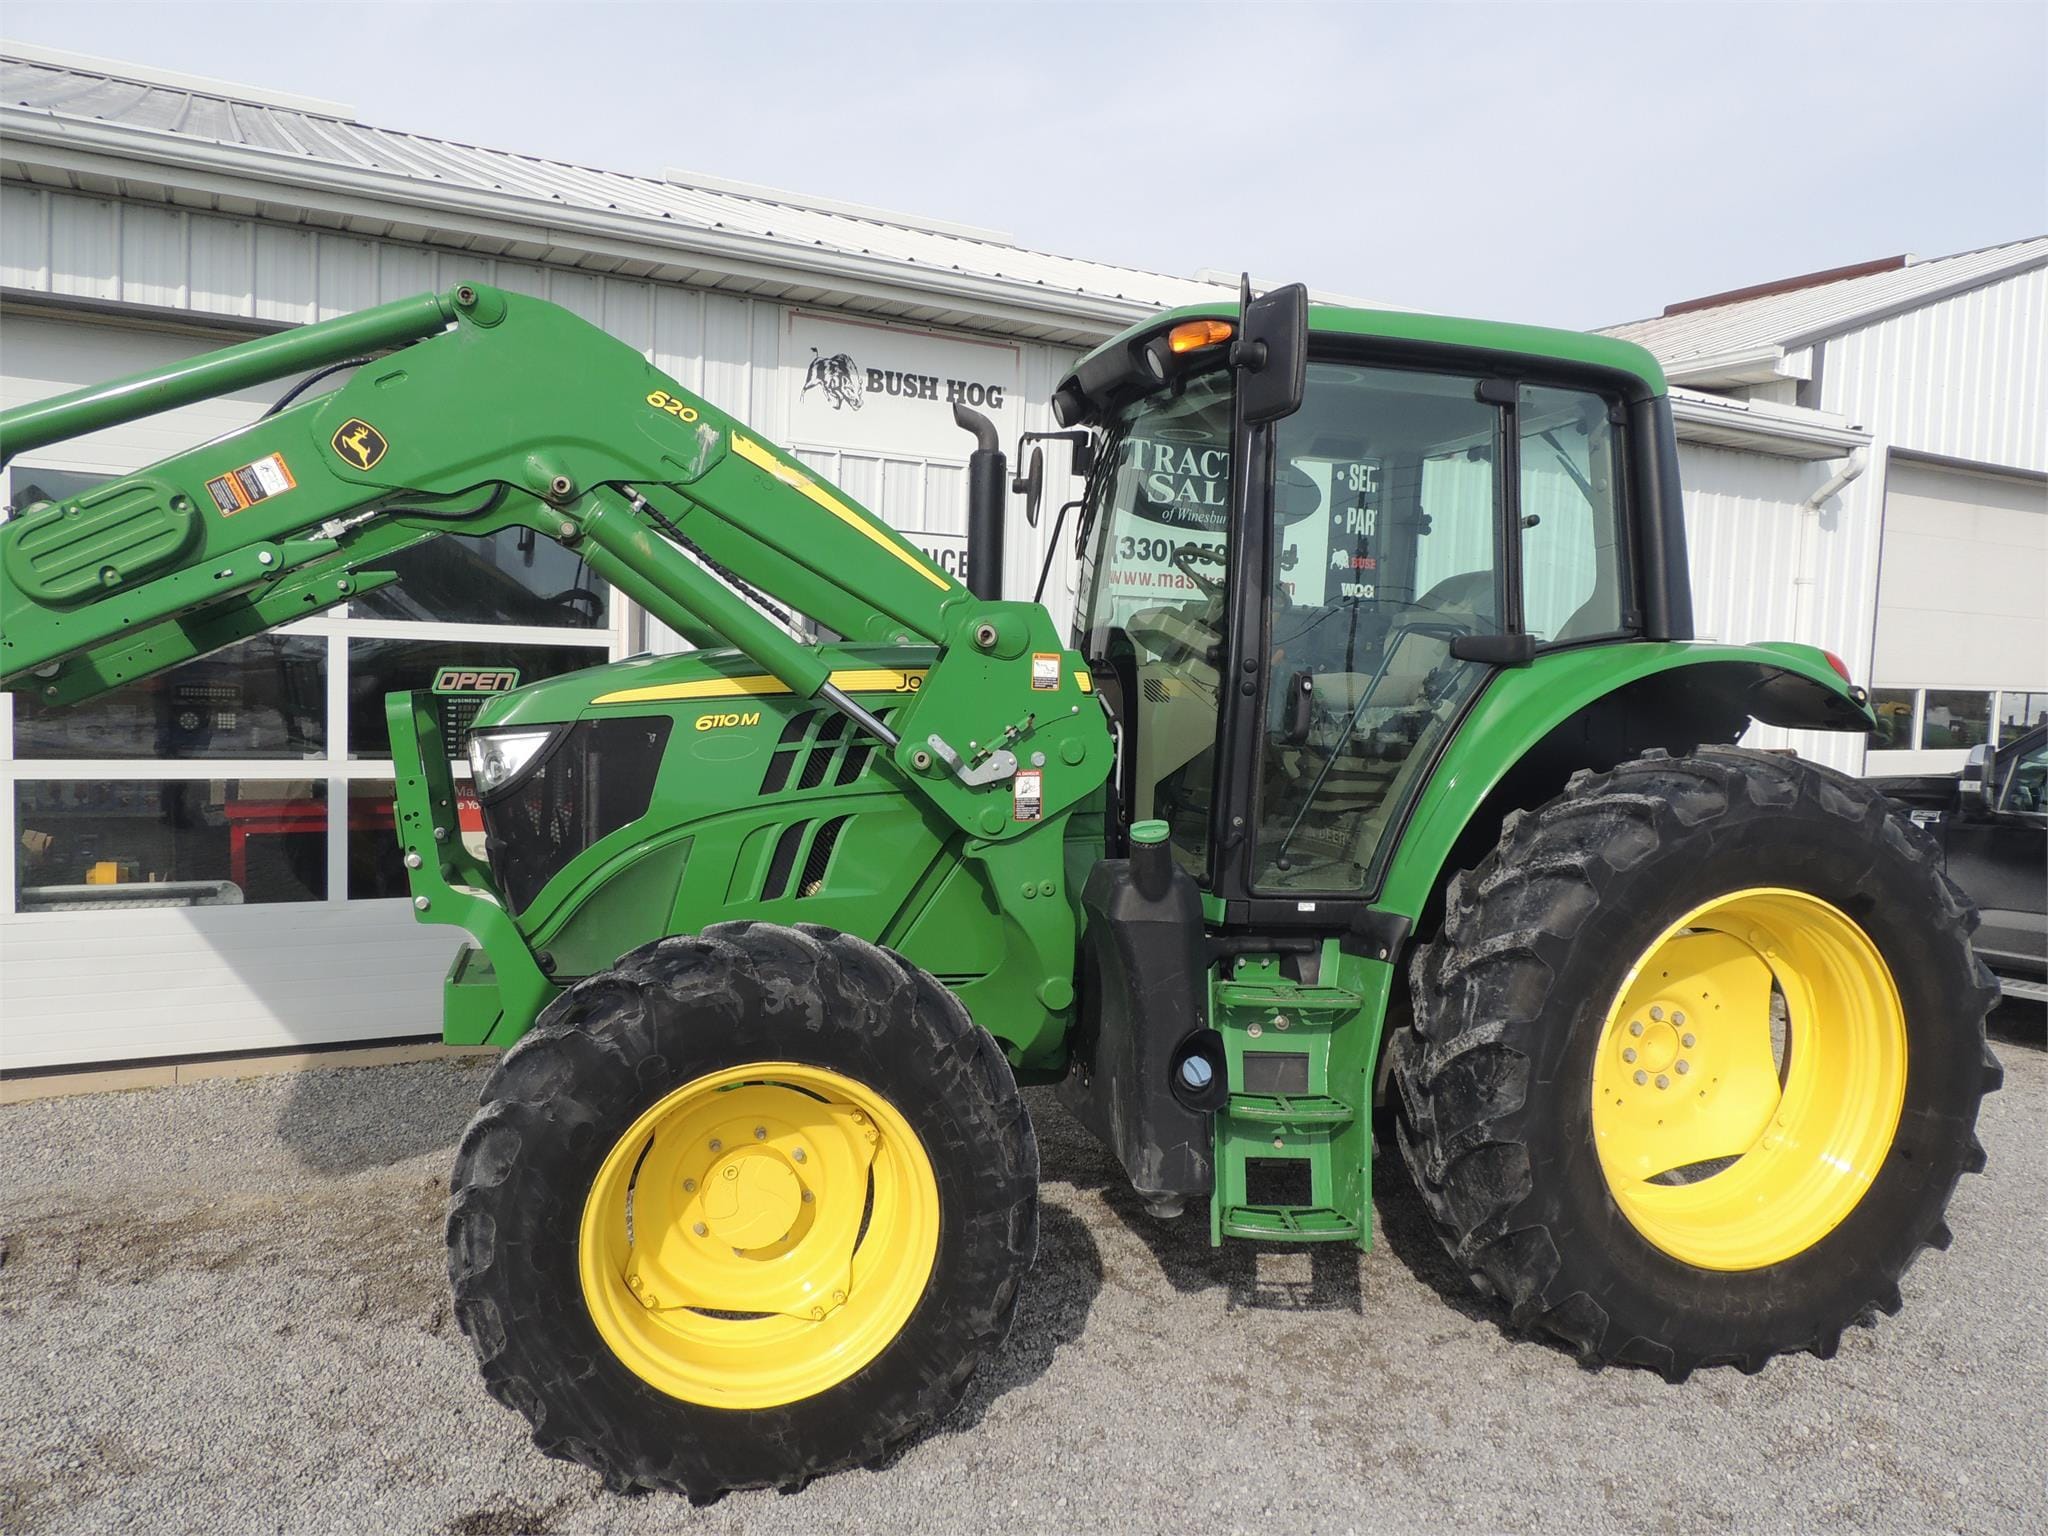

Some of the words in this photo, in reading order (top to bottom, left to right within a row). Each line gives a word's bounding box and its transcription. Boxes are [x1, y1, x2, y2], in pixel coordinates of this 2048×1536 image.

[865, 368, 938, 401] BUSH
[946, 379, 1003, 410] HOG
[645, 390, 700, 423] 620
[1147, 473, 1225, 506] SAL
[1162, 508, 1175, 523] of
[1346, 507, 1378, 537] PAR
[1112, 535, 1176, 568] (330)
[437, 672, 514, 690] OPEN
[455, 786, 476, 797] Ma
[466, 800, 481, 810] Yo
